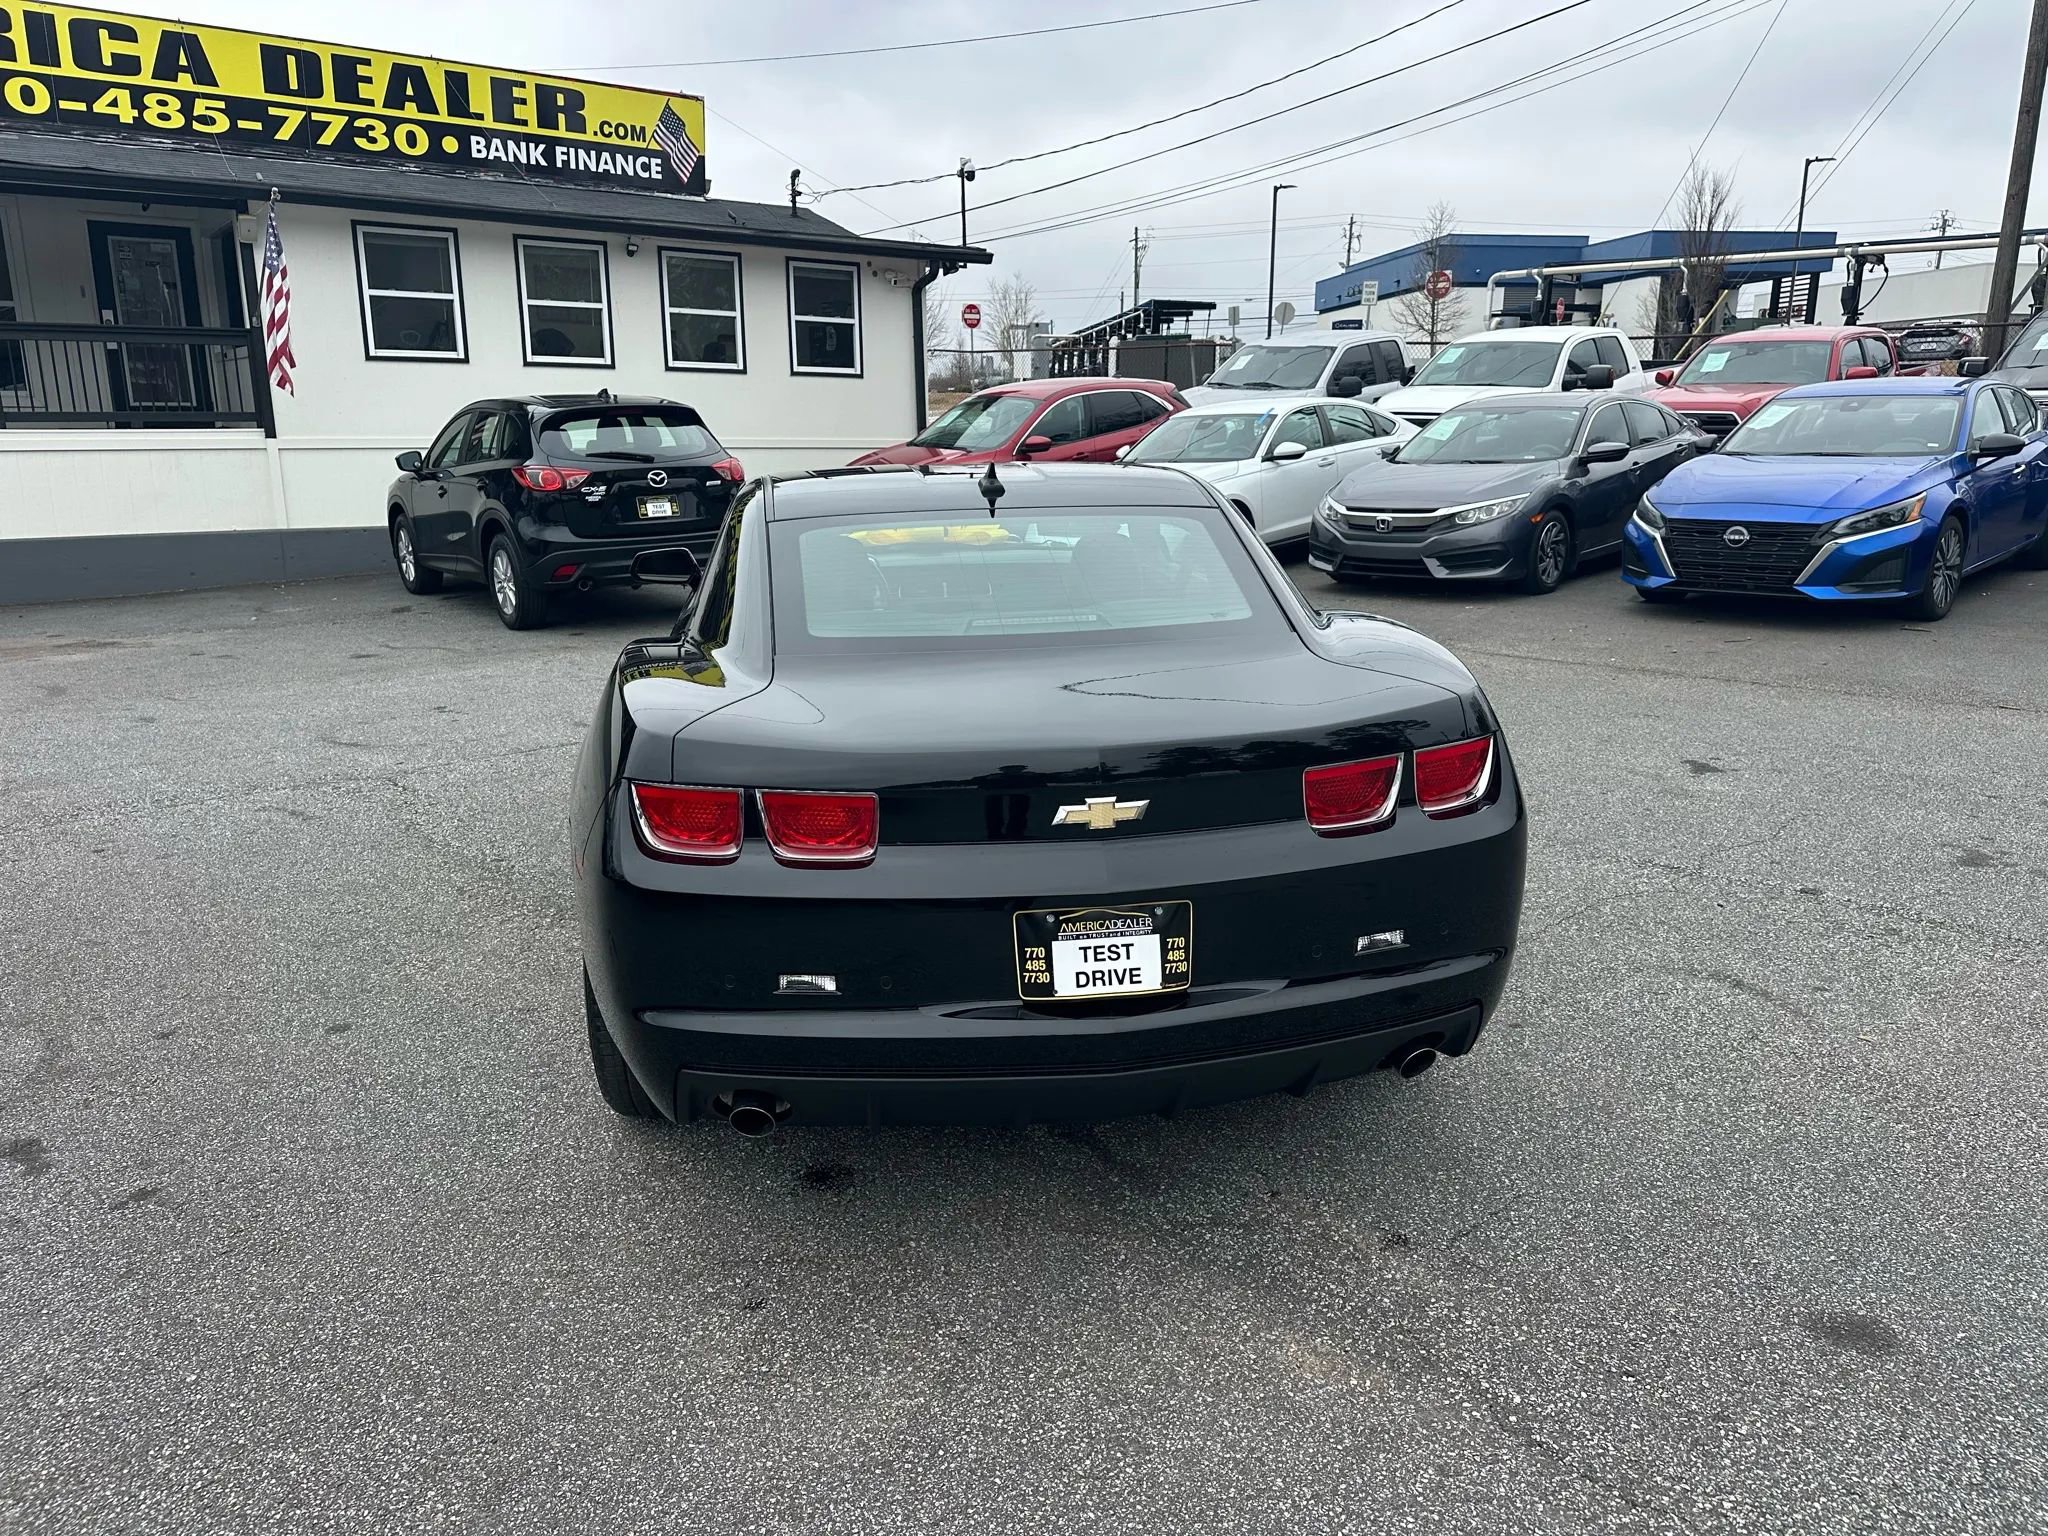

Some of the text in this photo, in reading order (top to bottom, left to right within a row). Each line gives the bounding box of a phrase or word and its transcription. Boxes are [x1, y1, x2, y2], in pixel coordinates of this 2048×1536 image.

[0, 7, 647, 143] ICA DEALER .COM
[470, 135, 548, 167] BANK
[555, 146, 663, 180] FINANCE
[1166, 937, 1185, 949] 770
[1024, 947, 1045, 959] 770
[1078, 943, 1135, 963] TEST
[1167, 949, 1186, 961] 485
[1025, 959, 1046, 971] 485
[1165, 961, 1188, 975] 7730
[1023, 972, 1050, 984] 7730
[1075, 967, 1142, 989] DRIVE
